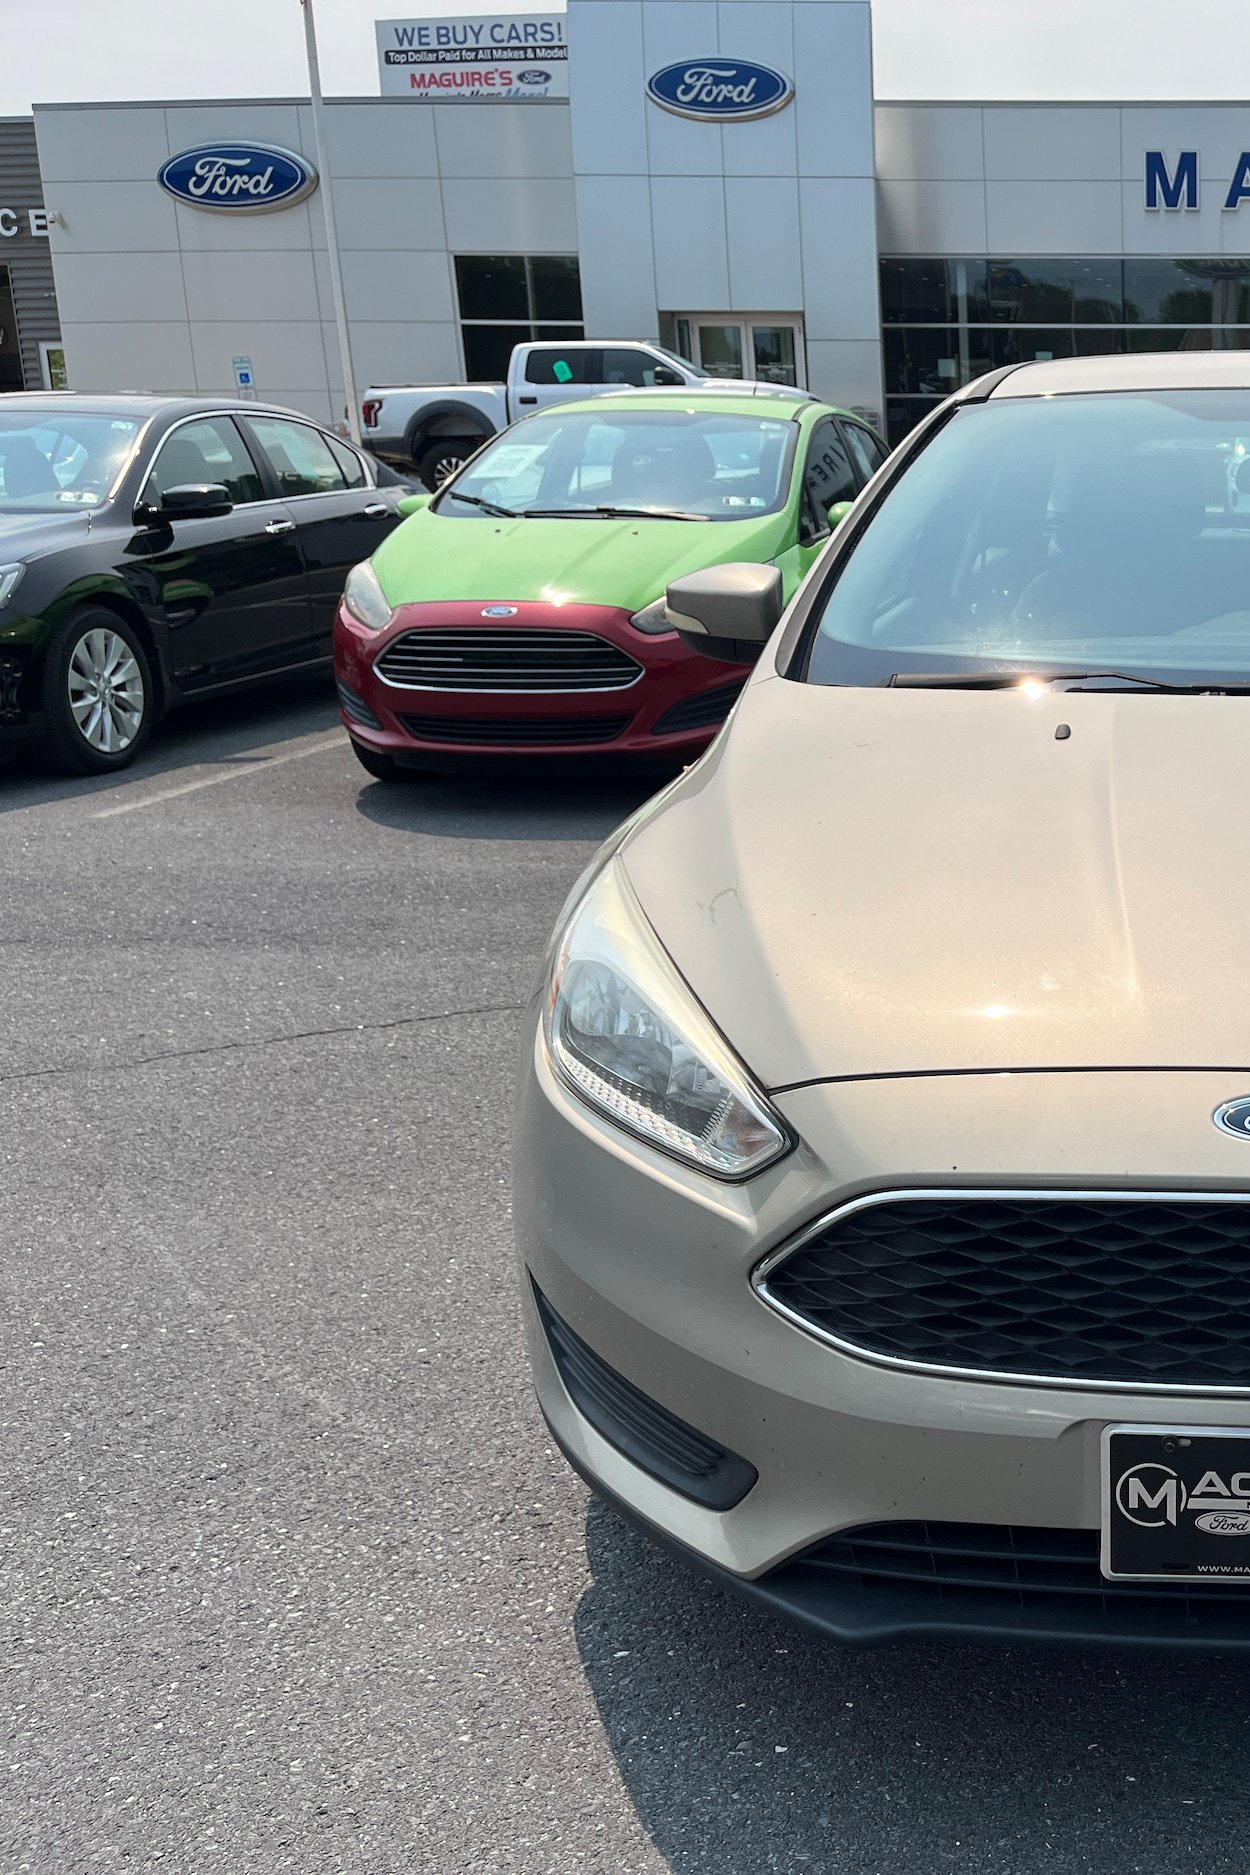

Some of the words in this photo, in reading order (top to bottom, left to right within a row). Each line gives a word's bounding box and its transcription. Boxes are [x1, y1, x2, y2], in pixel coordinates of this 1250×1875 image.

[394, 27, 431, 47] WE
[436, 24, 484, 46] BUY
[490, 22, 563, 44] CARS!
[388, 52, 407, 64] Top
[408, 51, 437, 62] Dollar
[438, 50, 460, 61] Paid
[461, 49, 475, 60] for
[478, 49, 492, 60] All
[492, 48, 525, 59] Makes
[526, 48, 535, 59] &
[409, 68, 513, 88] MAGUIRE'S
[676, 67, 757, 103] Ford
[188, 156, 274, 195] Ford
[1208, 1514, 1250, 1532] Ford
